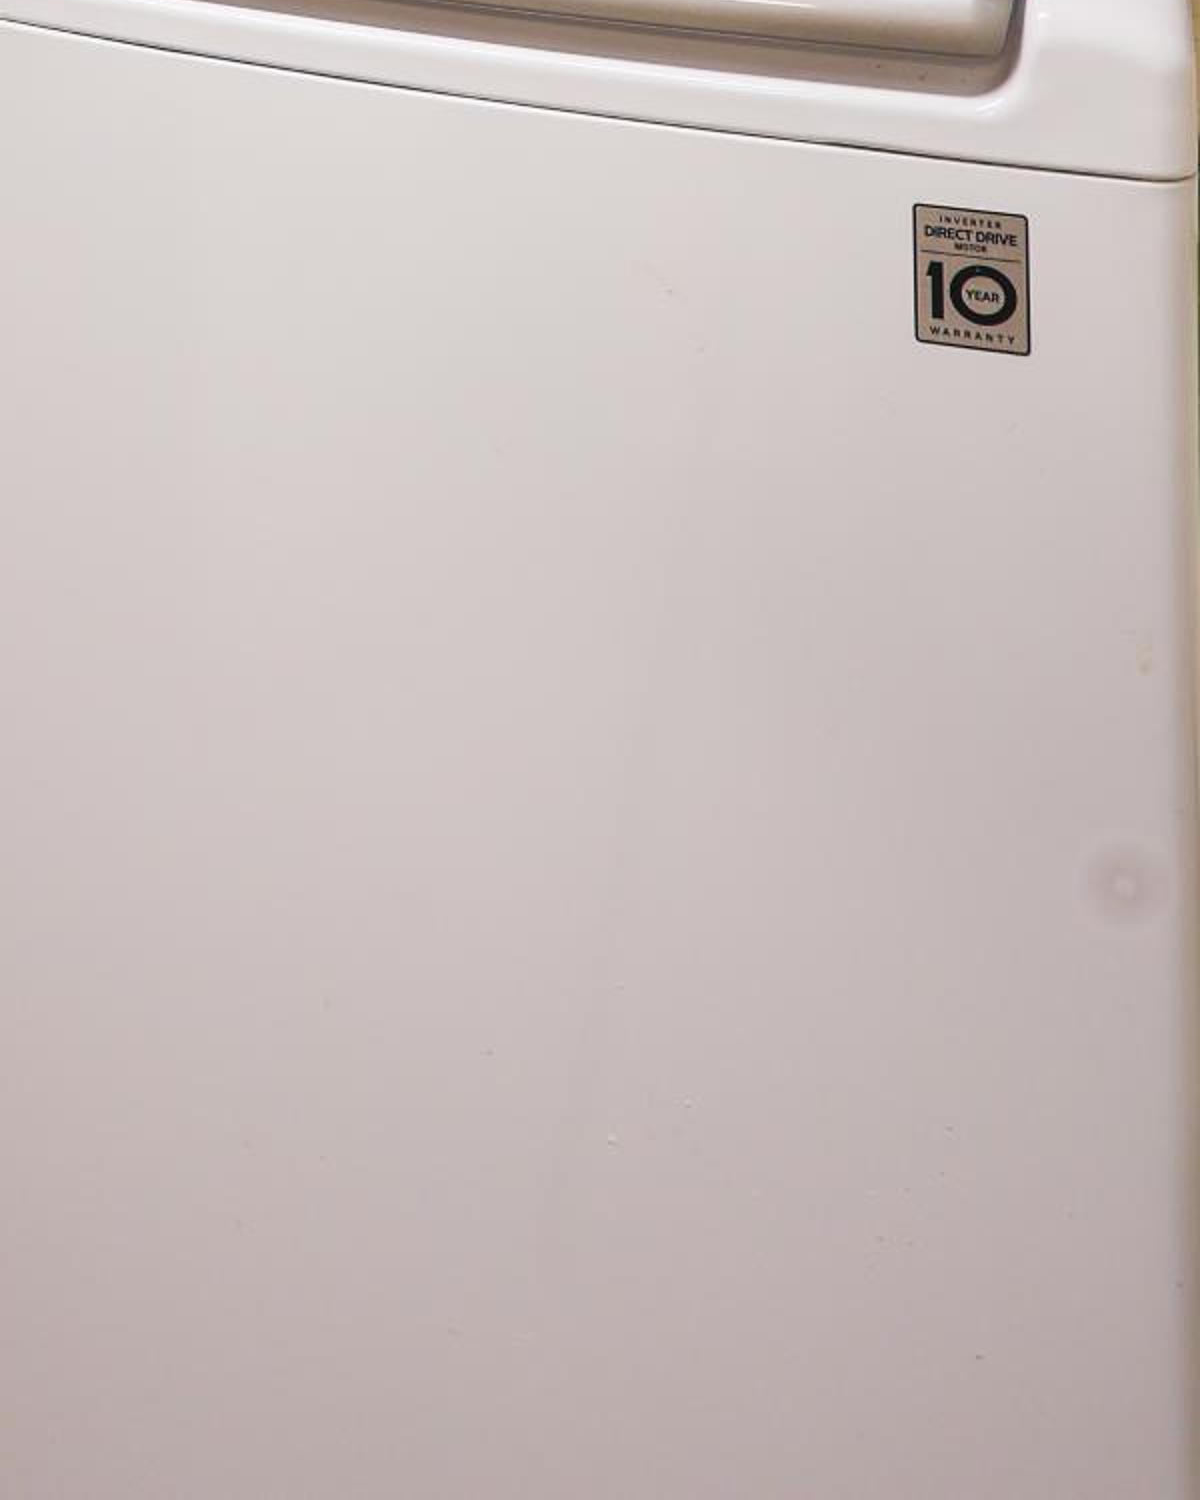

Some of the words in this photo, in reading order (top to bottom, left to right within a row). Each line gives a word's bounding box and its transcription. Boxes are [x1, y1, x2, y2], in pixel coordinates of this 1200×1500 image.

[939, 214, 1003, 230] INVERTER
[924, 224, 973, 242] DIRECT
[975, 231, 1019, 247] DRIVE
[954, 242, 988, 253] MOTOR
[925, 259, 1018, 327] 10
[965, 288, 1000, 303] YEAR
[929, 325, 1016, 345] WARRANTY
